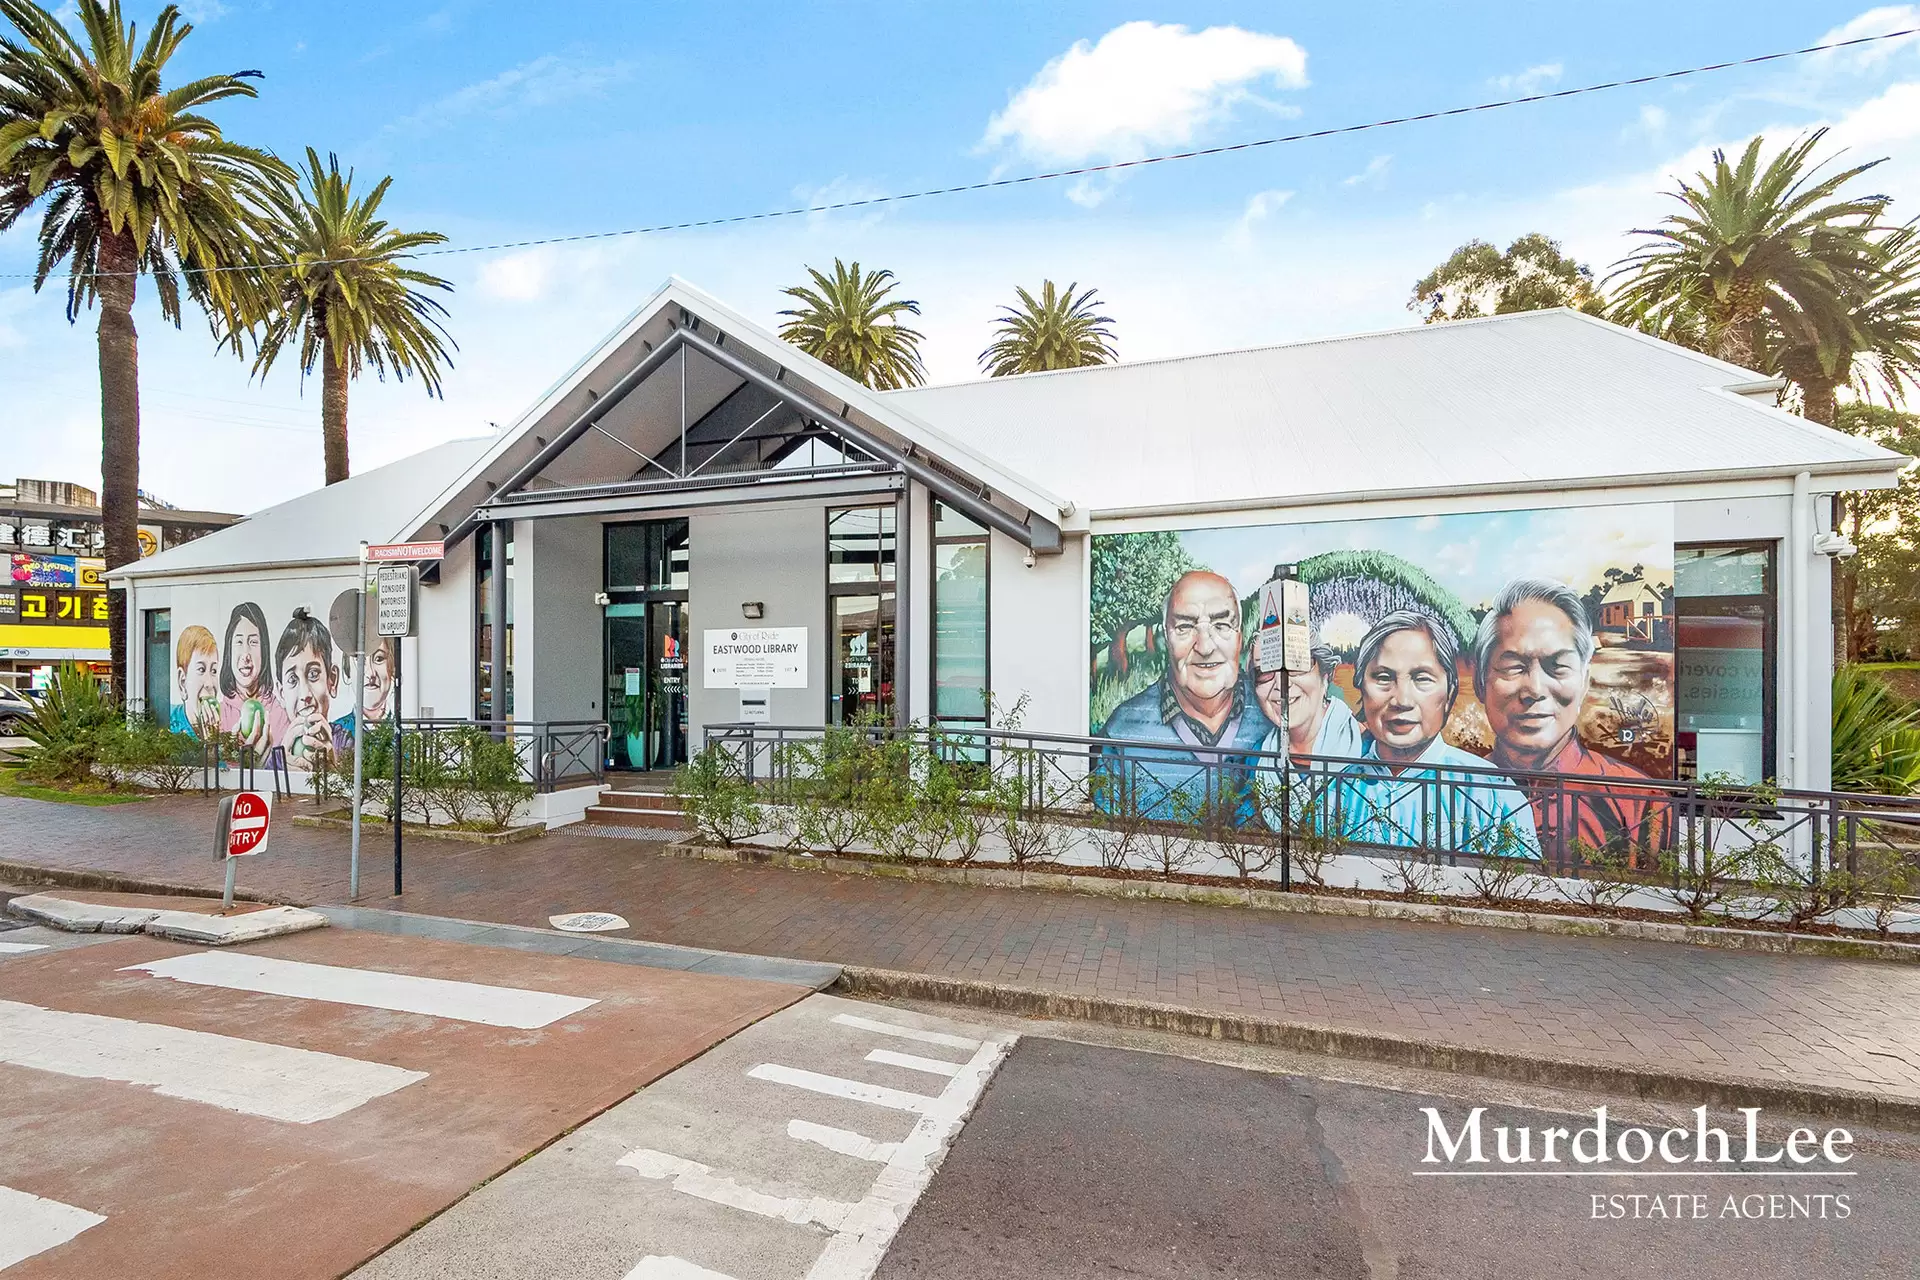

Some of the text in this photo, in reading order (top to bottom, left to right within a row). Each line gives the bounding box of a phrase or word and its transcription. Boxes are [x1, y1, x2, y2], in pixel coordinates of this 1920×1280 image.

[380, 572, 407, 581] PEDESTRIANS
[381, 584, 406, 594] CONSIDER
[380, 596, 406, 606] MOTORISTS
[380, 609, 407, 618] AND CROSS
[380, 621, 406, 631] IN GROUPS
[713, 643, 798, 655] EASTWOOD LIBRARY
[235, 802, 252, 816] NO
